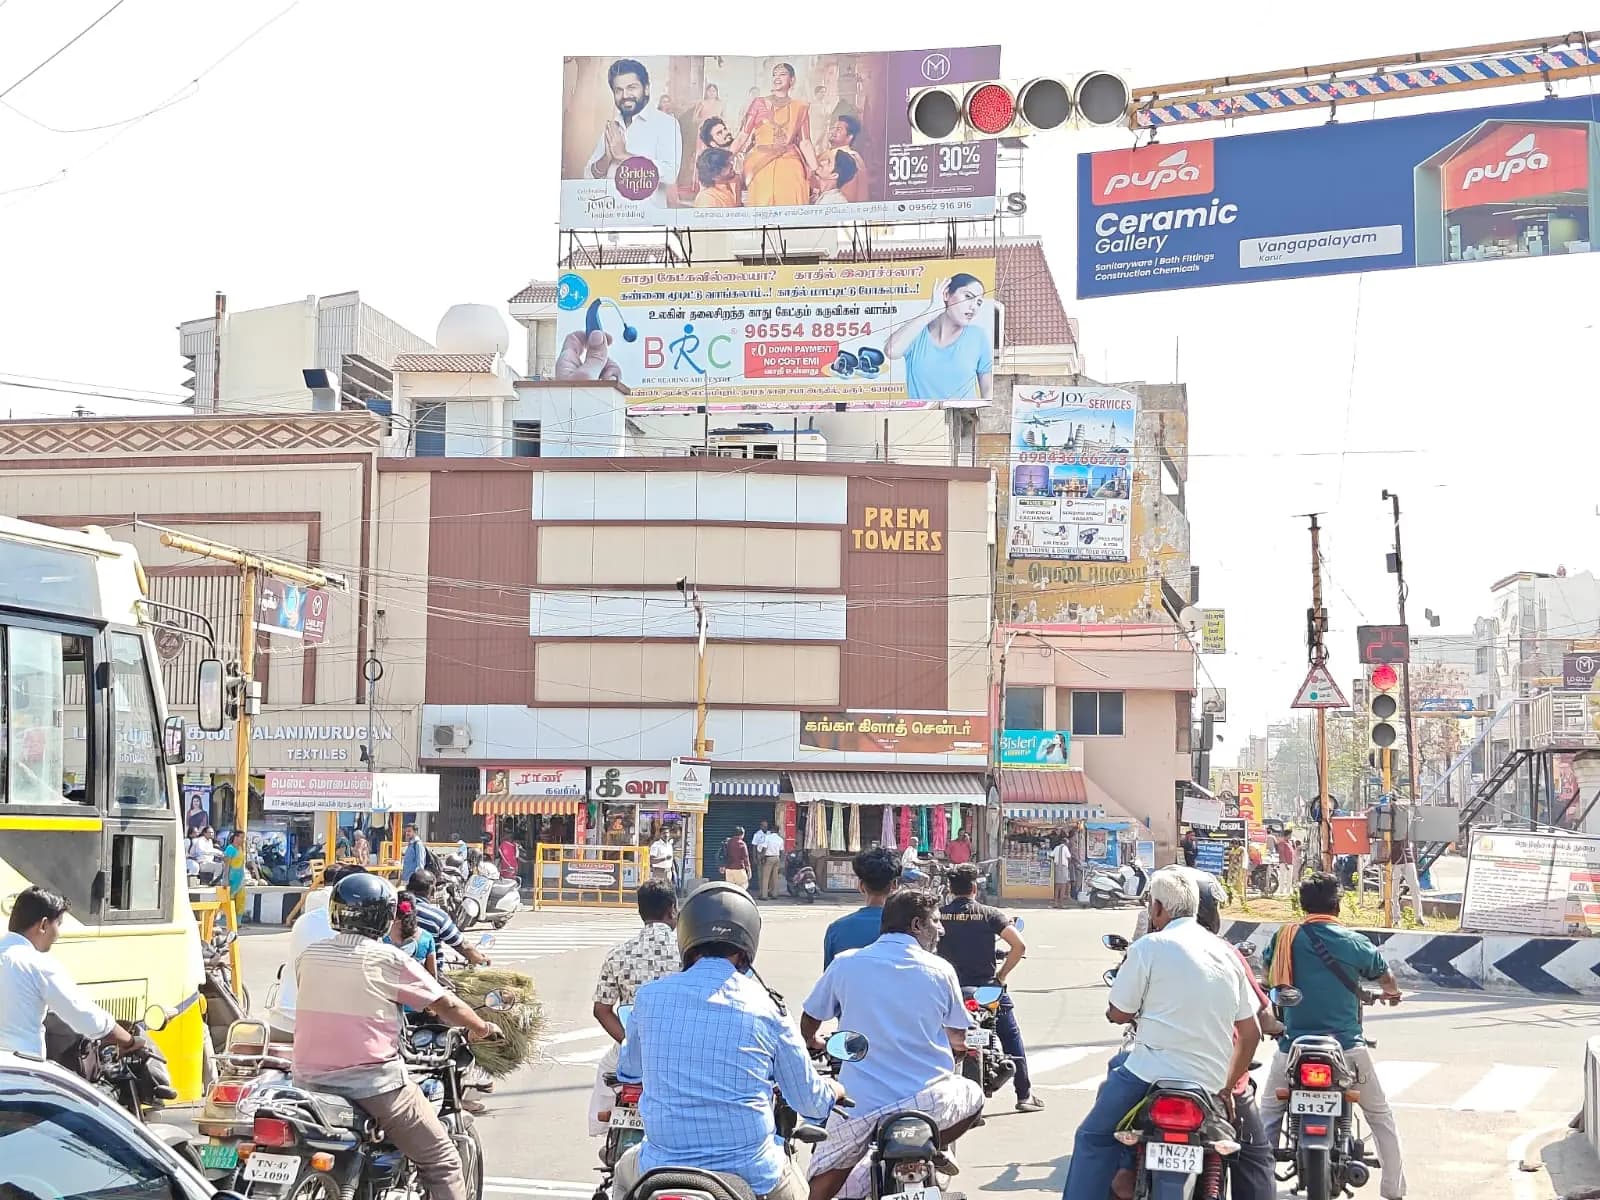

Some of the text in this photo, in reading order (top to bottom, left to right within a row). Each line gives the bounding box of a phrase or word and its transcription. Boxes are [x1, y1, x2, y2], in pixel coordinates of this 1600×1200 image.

[620, 165, 655, 179] Brides
[1462, 151, 1549, 189] pupa
[625, 179, 652, 193] India
[1103, 165, 1200, 196] pupa
[909, 201, 972, 212] 09562 916 916
[1007, 192, 1027, 215] S
[1095, 198, 1239, 237] Ceramic
[1095, 234, 1168, 254] Gallery
[1257, 230, 1377, 253] Vangapalayam
[1095, 257, 1152, 271] Sanitaryware
[1159, 256, 1180, 266] Bath
[1182, 252, 1215, 265] Fittings
[1259, 253, 1282, 263] Karur
[621, 269, 776, 285] காது கேட்கவில்லையா?
[794, 265, 924, 281] காதில் இரைச்சலா?
[1095, 263, 1200, 281] Construction Chemicals
[777, 286, 809, 298] காதில்
[649, 301, 898, 321] உலகின் தலைசிறந்த காது கேட்கும் கருவிகள் வாங்க
[745, 321, 872, 339] 96554 88554
[768, 346, 793, 354] DOWN
[795, 344, 831, 353] PAYMENT
[763, 357, 819, 366] NO COST EMI
[1061, 391, 1131, 410] JOY SERVICES
[864, 506, 929, 529] PREM
[851, 529, 943, 551] TOWERS
[250, 726, 392, 741] ALANIMURUGAN
[805, 716, 972, 736] கங்கா கிளாத் சென்டர்
[1000, 735, 1037, 750] Bisleri
[287, 748, 347, 760] TEXTILES
[514, 770, 563, 786] ராணி
[545, 784, 580, 796] கவரிங்
[1297, 1101, 1337, 1113] 8137
[893, 1130, 915, 1138] TVS
[1159, 1144, 1196, 1159] TN47A
[1158, 1156, 1196, 1171] M6512
[251, 1169, 290, 1180] V-1099
